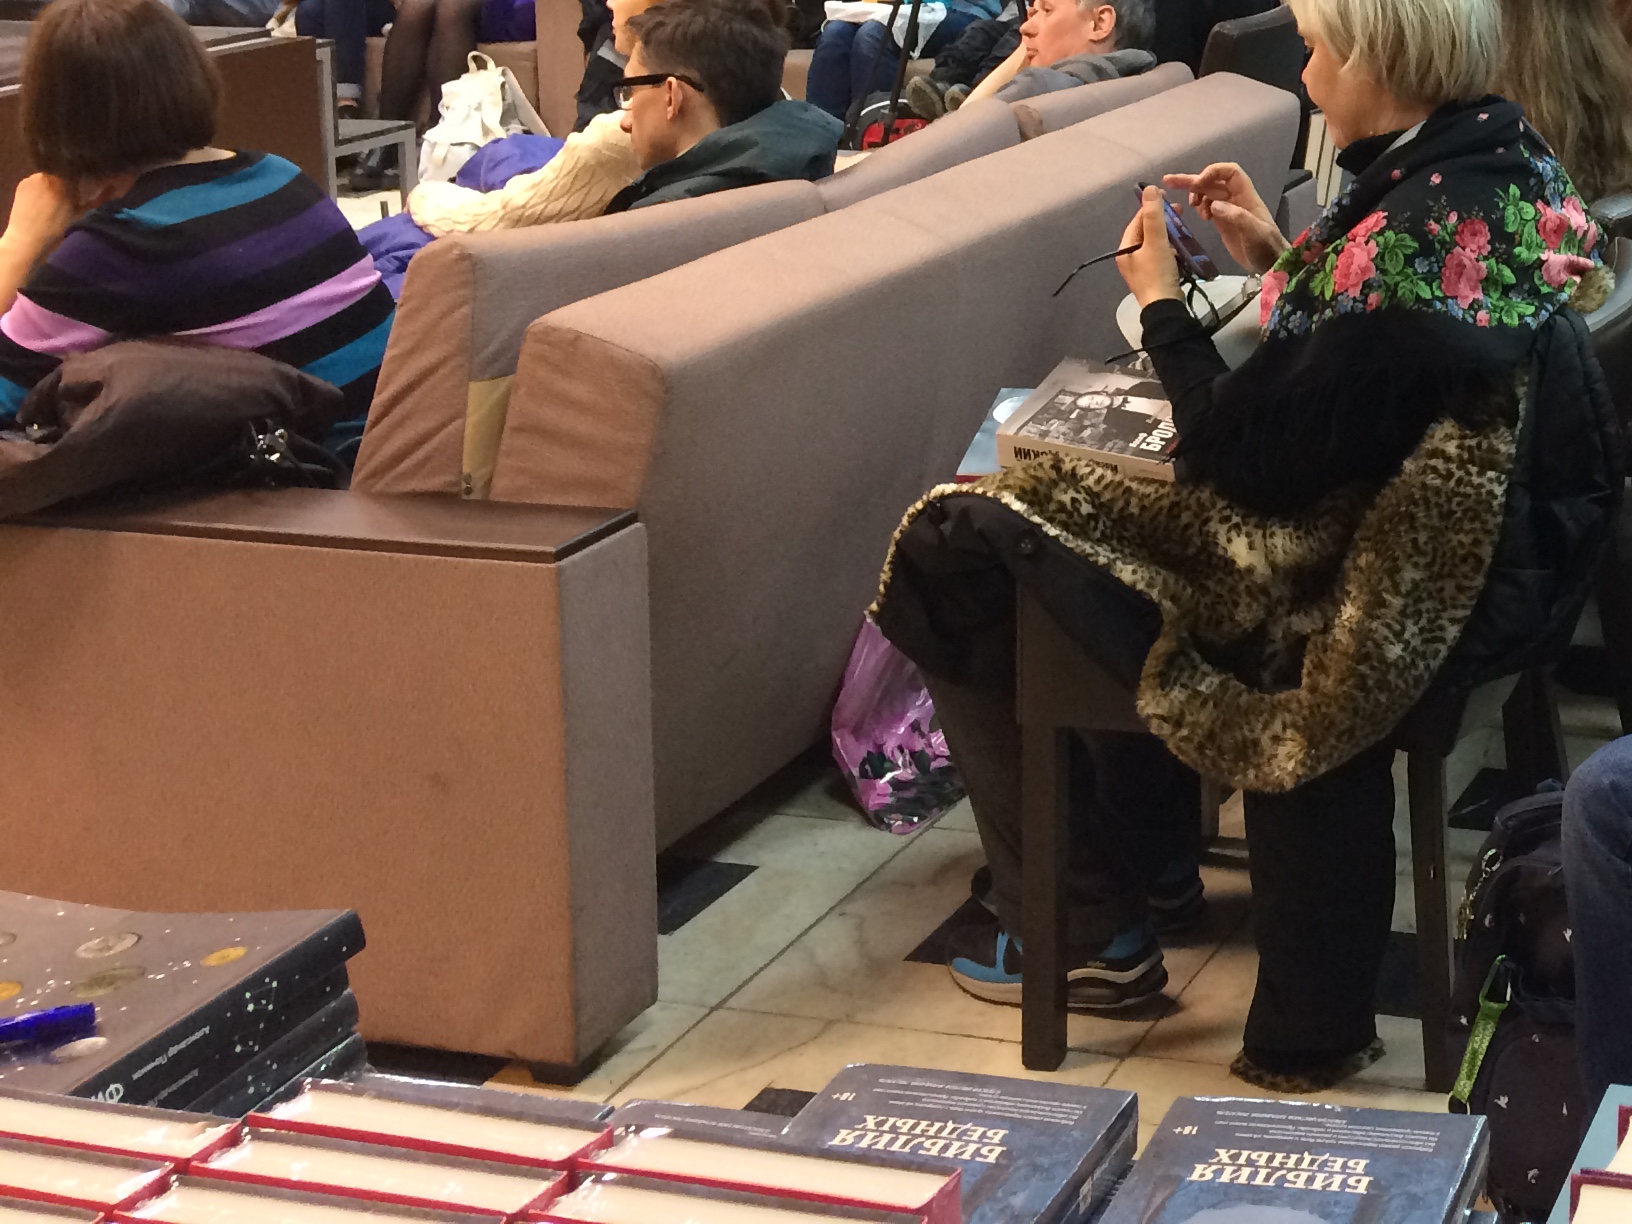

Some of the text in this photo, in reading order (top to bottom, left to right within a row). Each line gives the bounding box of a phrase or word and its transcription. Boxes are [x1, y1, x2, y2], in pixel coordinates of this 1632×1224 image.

[831, 1090, 857, 1102] 18+
[854, 1114, 1009, 1144] БЕДНЫХ
[1173, 1124, 1199, 1136] 18+
[827, 1128, 1007, 1164] БИБЛИЯ
[1208, 1147, 1370, 1174] БЕДНЫХ
[1186, 1163, 1374, 1195] БИБЛИЯ
